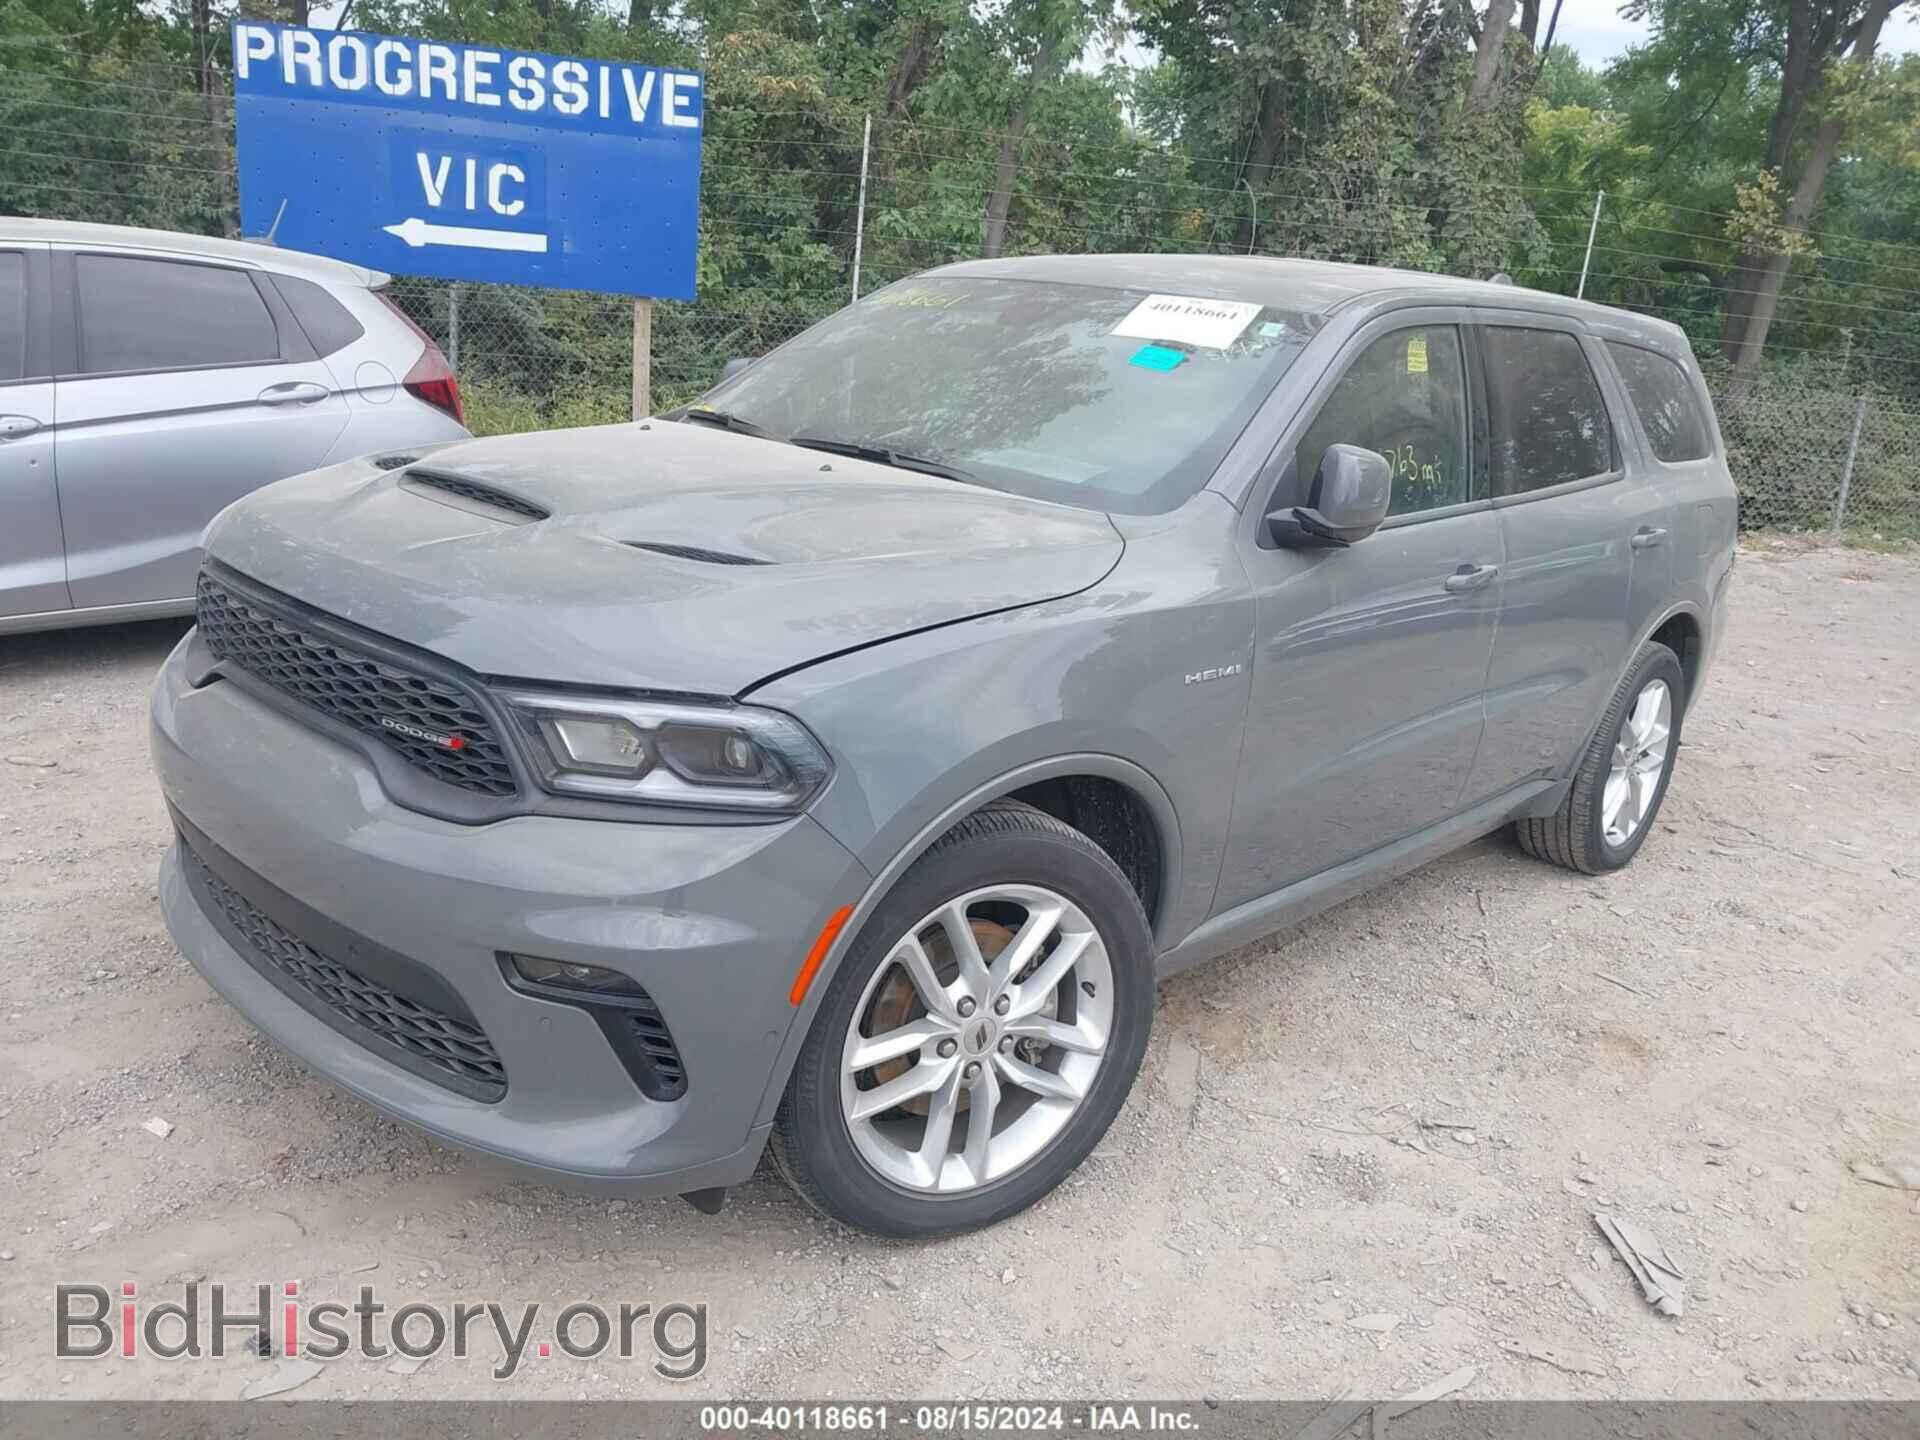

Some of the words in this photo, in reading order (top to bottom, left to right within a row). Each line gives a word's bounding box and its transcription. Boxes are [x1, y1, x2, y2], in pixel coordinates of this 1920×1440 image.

[236, 25, 700, 128] PROGRESSIVE
[416, 152, 526, 217] VIC
[1184, 664, 1241, 685] HEMI
[381, 718, 450, 747] DODGE
